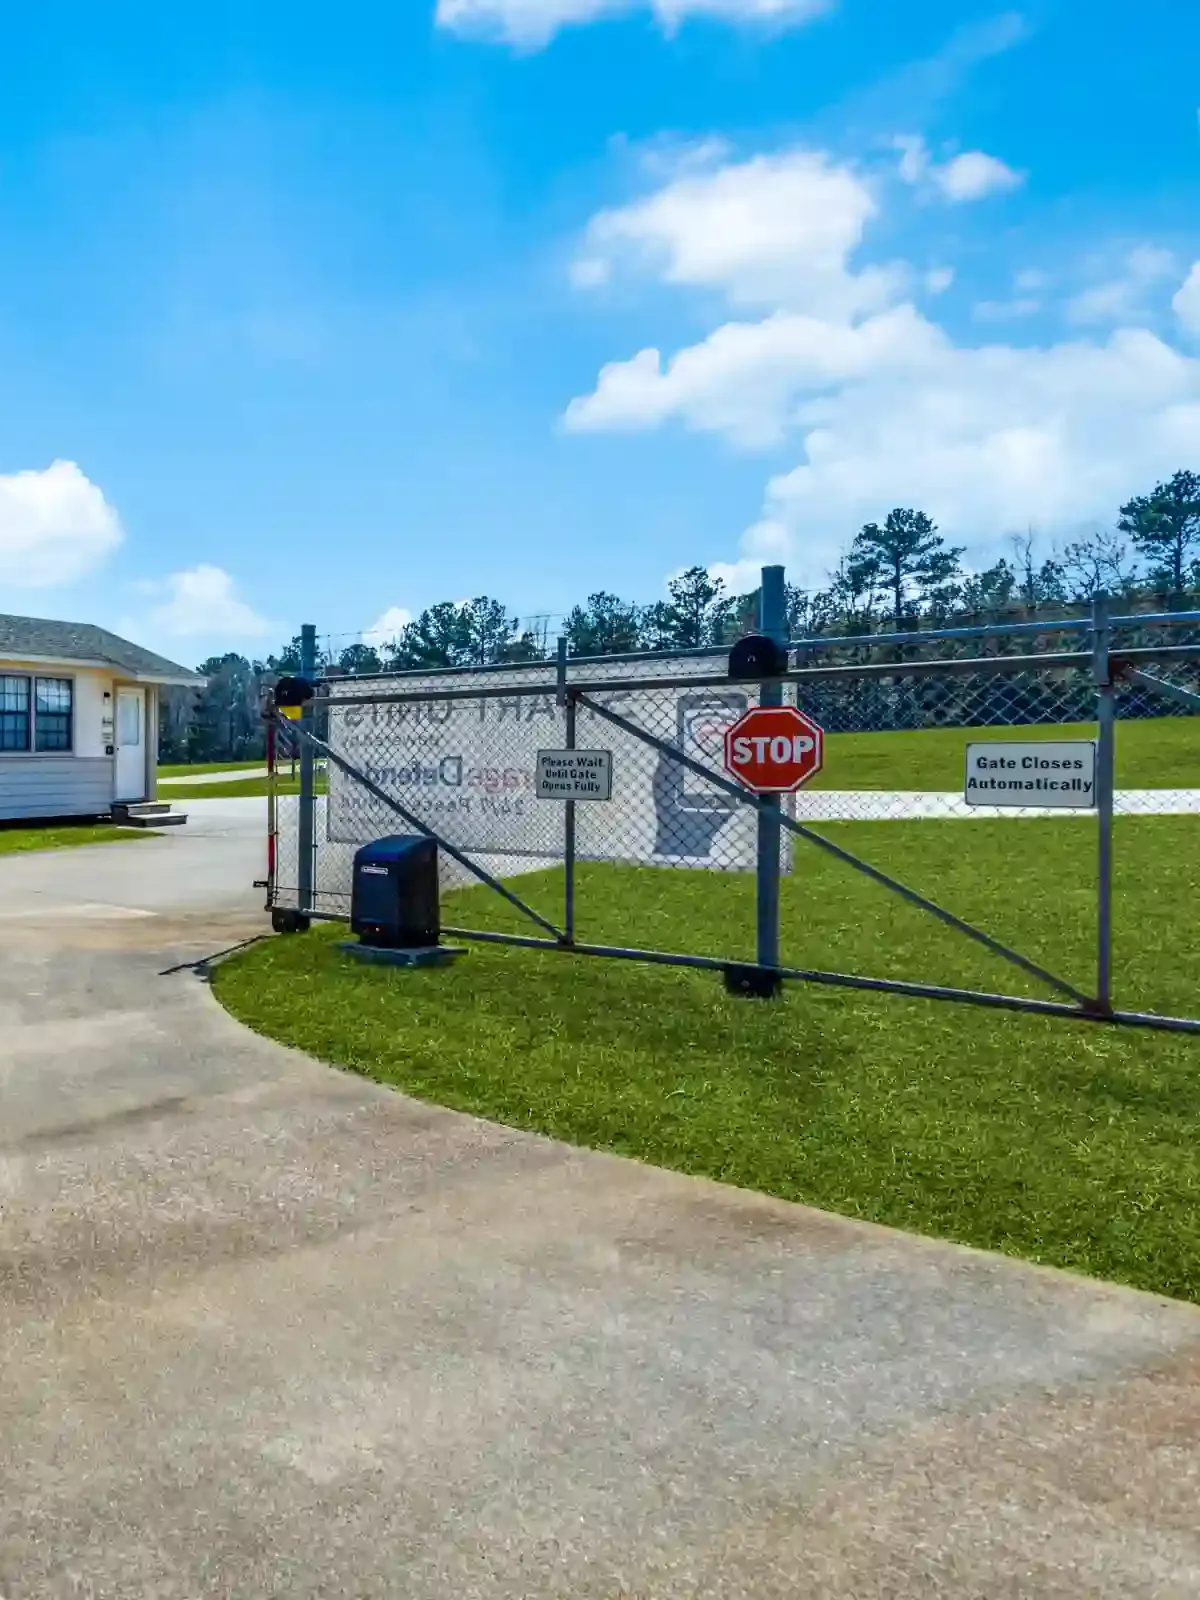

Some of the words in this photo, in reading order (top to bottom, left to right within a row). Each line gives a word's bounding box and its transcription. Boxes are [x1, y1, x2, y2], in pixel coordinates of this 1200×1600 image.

[733, 735, 814, 764] STOP
[541, 756, 574, 767] Please
[976, 757, 1017, 769] Gate
[1021, 757, 1083, 769] Closes
[546, 768, 568, 778] Until
[570, 769, 597, 779] Gate
[542, 781, 572, 792] Opens
[574, 781, 600, 792] Fully
[967, 777, 1093, 792] Automatically
